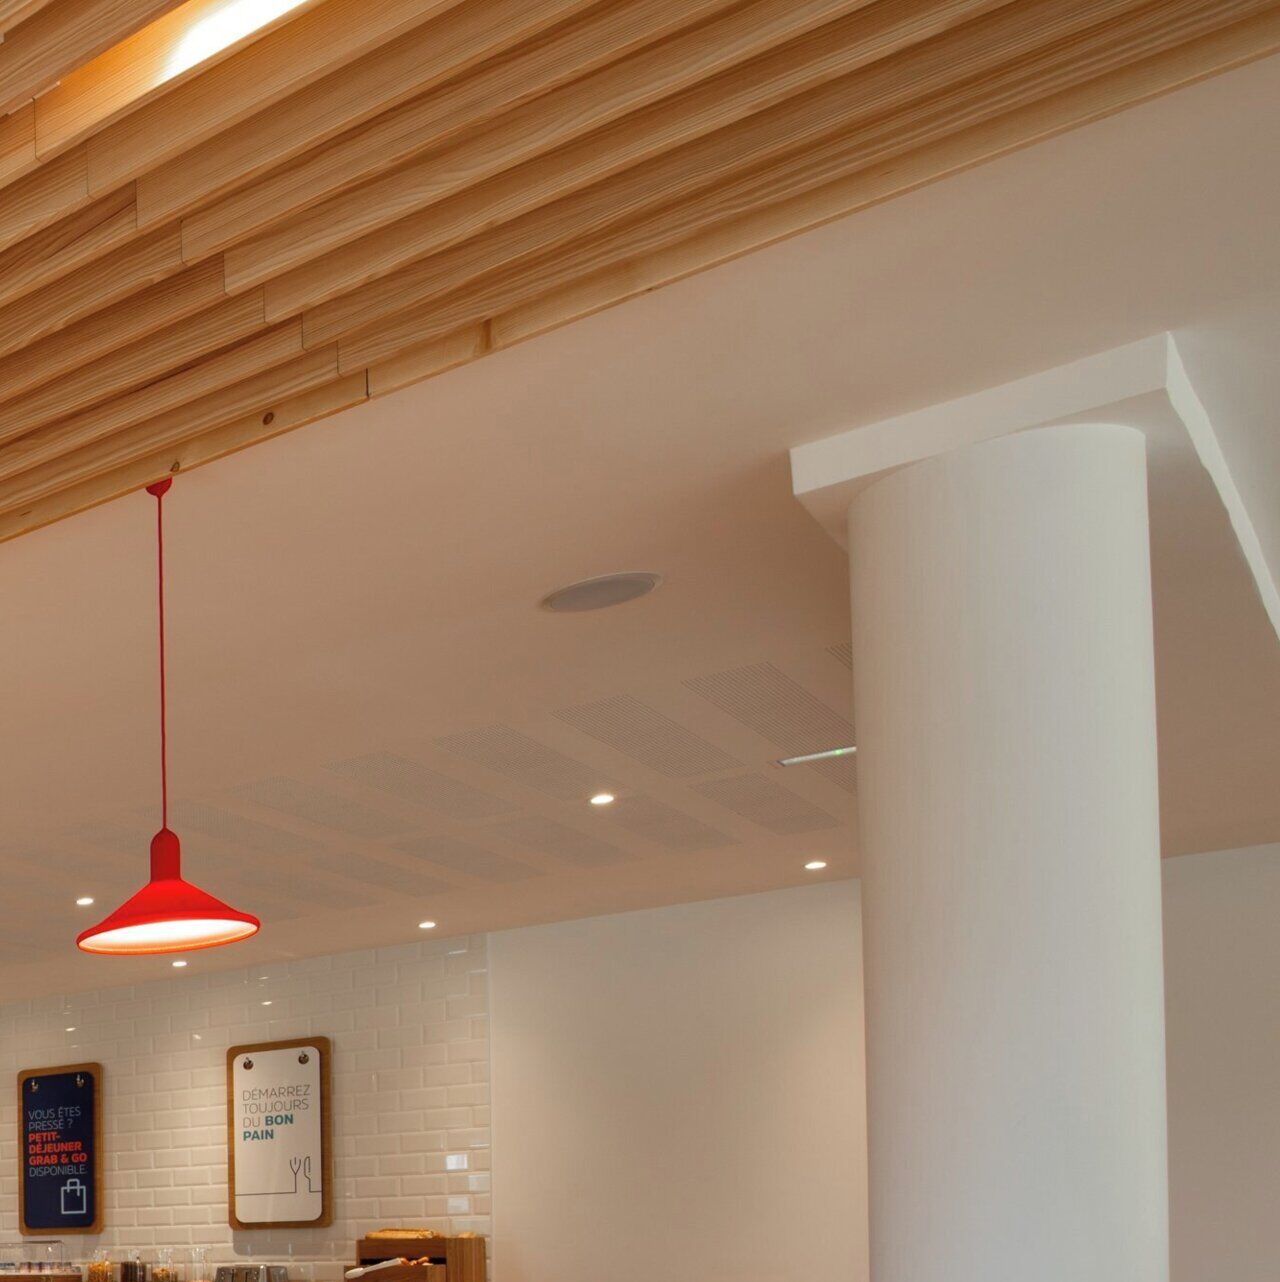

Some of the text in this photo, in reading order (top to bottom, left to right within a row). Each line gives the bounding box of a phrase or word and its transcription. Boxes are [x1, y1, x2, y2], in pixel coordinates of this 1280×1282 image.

[243, 1084, 311, 1101] DÉMARREZ
[28, 1106, 81, 1120] VOUS ÊTES
[243, 1099, 309, 1114] TOUJOURS
[243, 1114, 293, 1128] DU BON
[28, 1132, 60, 1142] PETIT-
[243, 1129, 274, 1141] PAIN
[29, 1153, 87, 1165] GRAB & GO
[29, 1164, 87, 1177] DISPONIBLE
